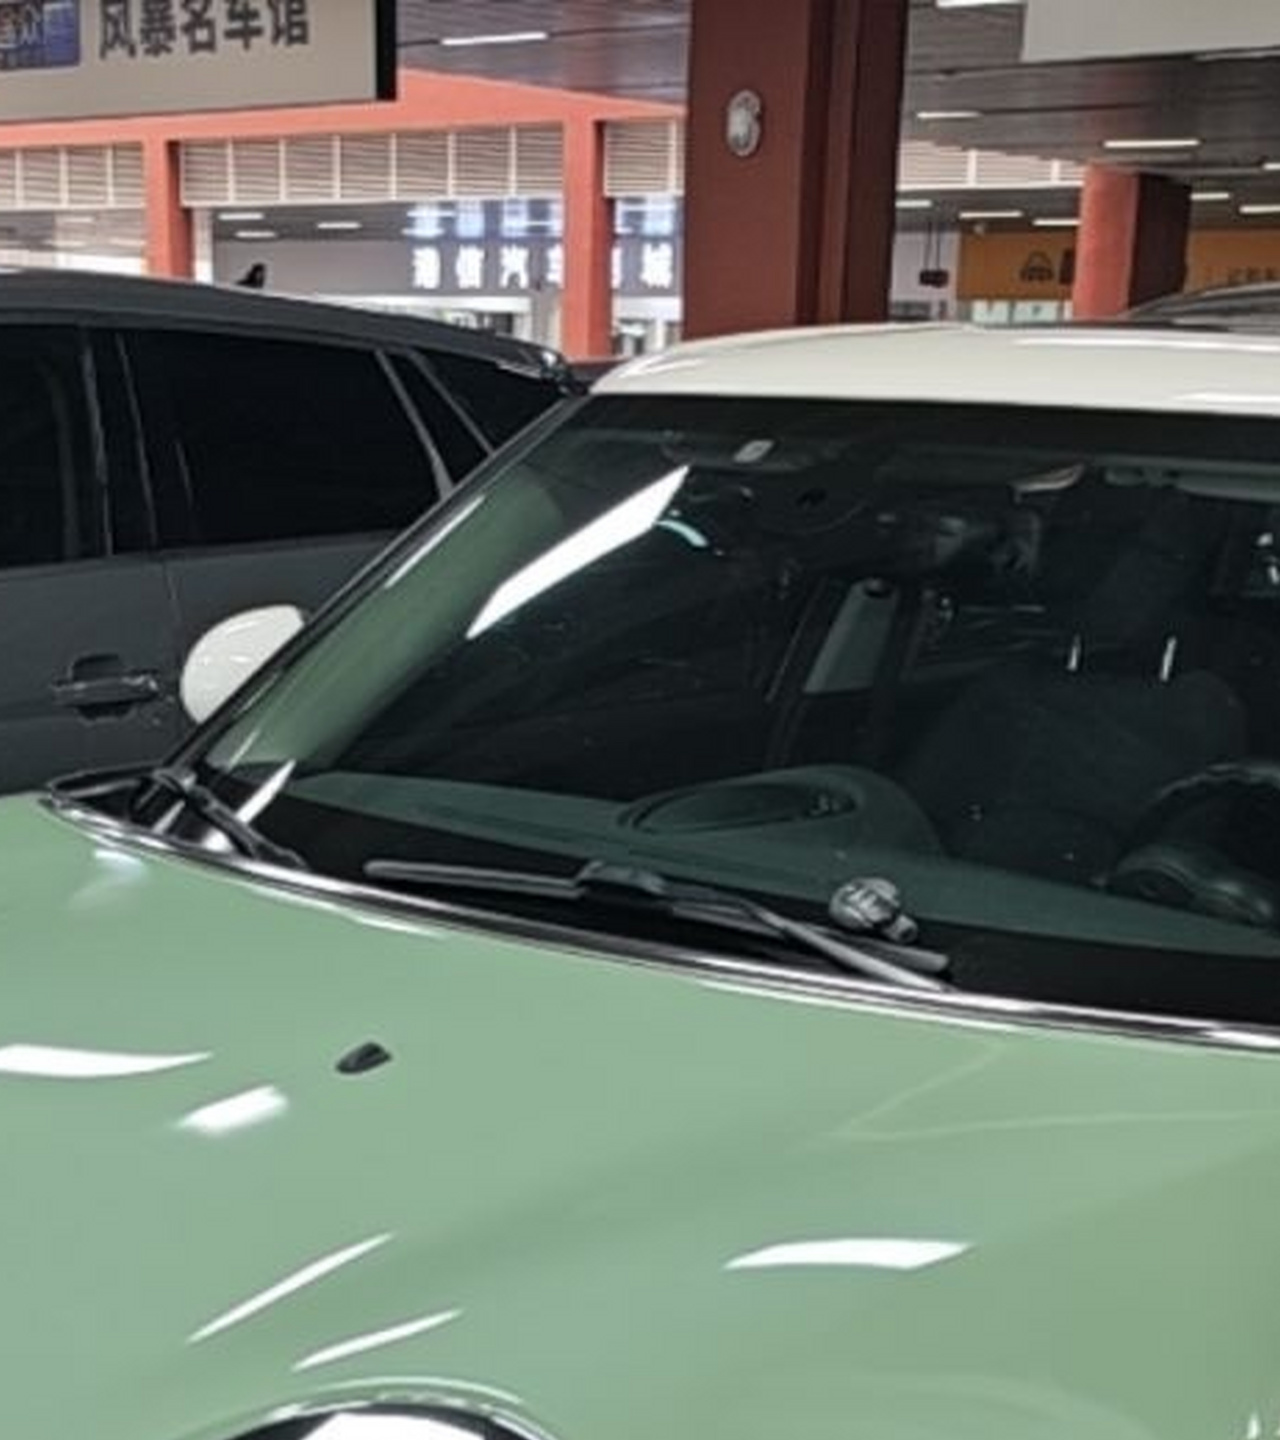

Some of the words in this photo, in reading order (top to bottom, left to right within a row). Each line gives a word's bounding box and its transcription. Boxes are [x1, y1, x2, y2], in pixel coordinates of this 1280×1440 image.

[98, 0, 312, 59] 风暴名车馆
